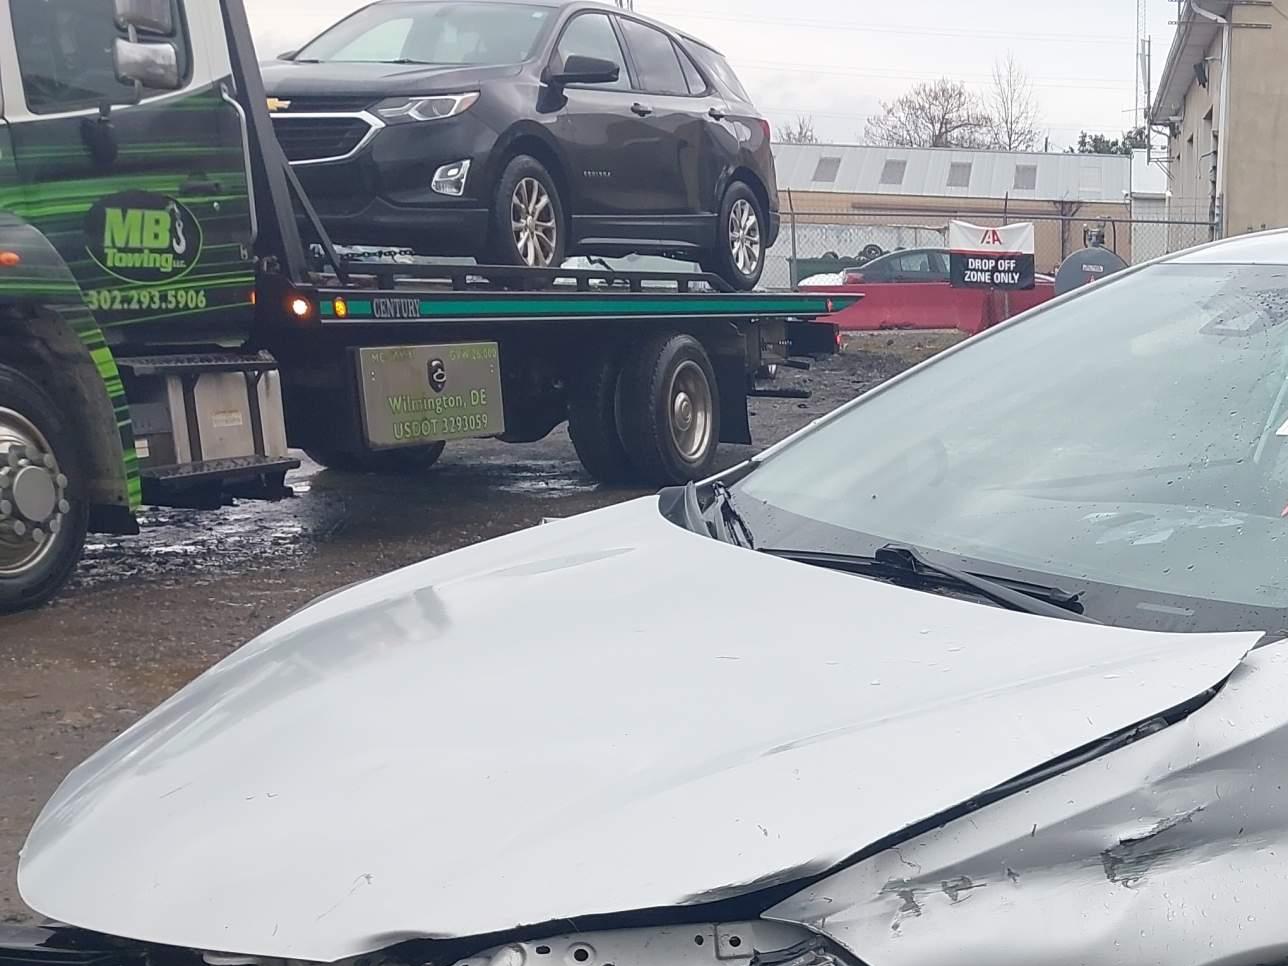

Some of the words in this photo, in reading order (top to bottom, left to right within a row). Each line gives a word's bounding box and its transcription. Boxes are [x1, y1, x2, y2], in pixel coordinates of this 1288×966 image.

[104, 207, 171, 249] MB
[104, 248, 173, 272] Towing
[968, 258, 995, 271] DROP
[998, 259, 1016, 271] OFF
[964, 270, 991, 283] ZONE
[993, 271, 1020, 284] ONLY
[87, 289, 207, 310] 302.293.5906
[373, 298, 420, 318] CENTURY
[388, 394, 466, 413] Wilmington,
[470, 388, 487, 406] DE
[393, 419, 438, 439] USDOT
[442, 413, 488, 433] 3293059
